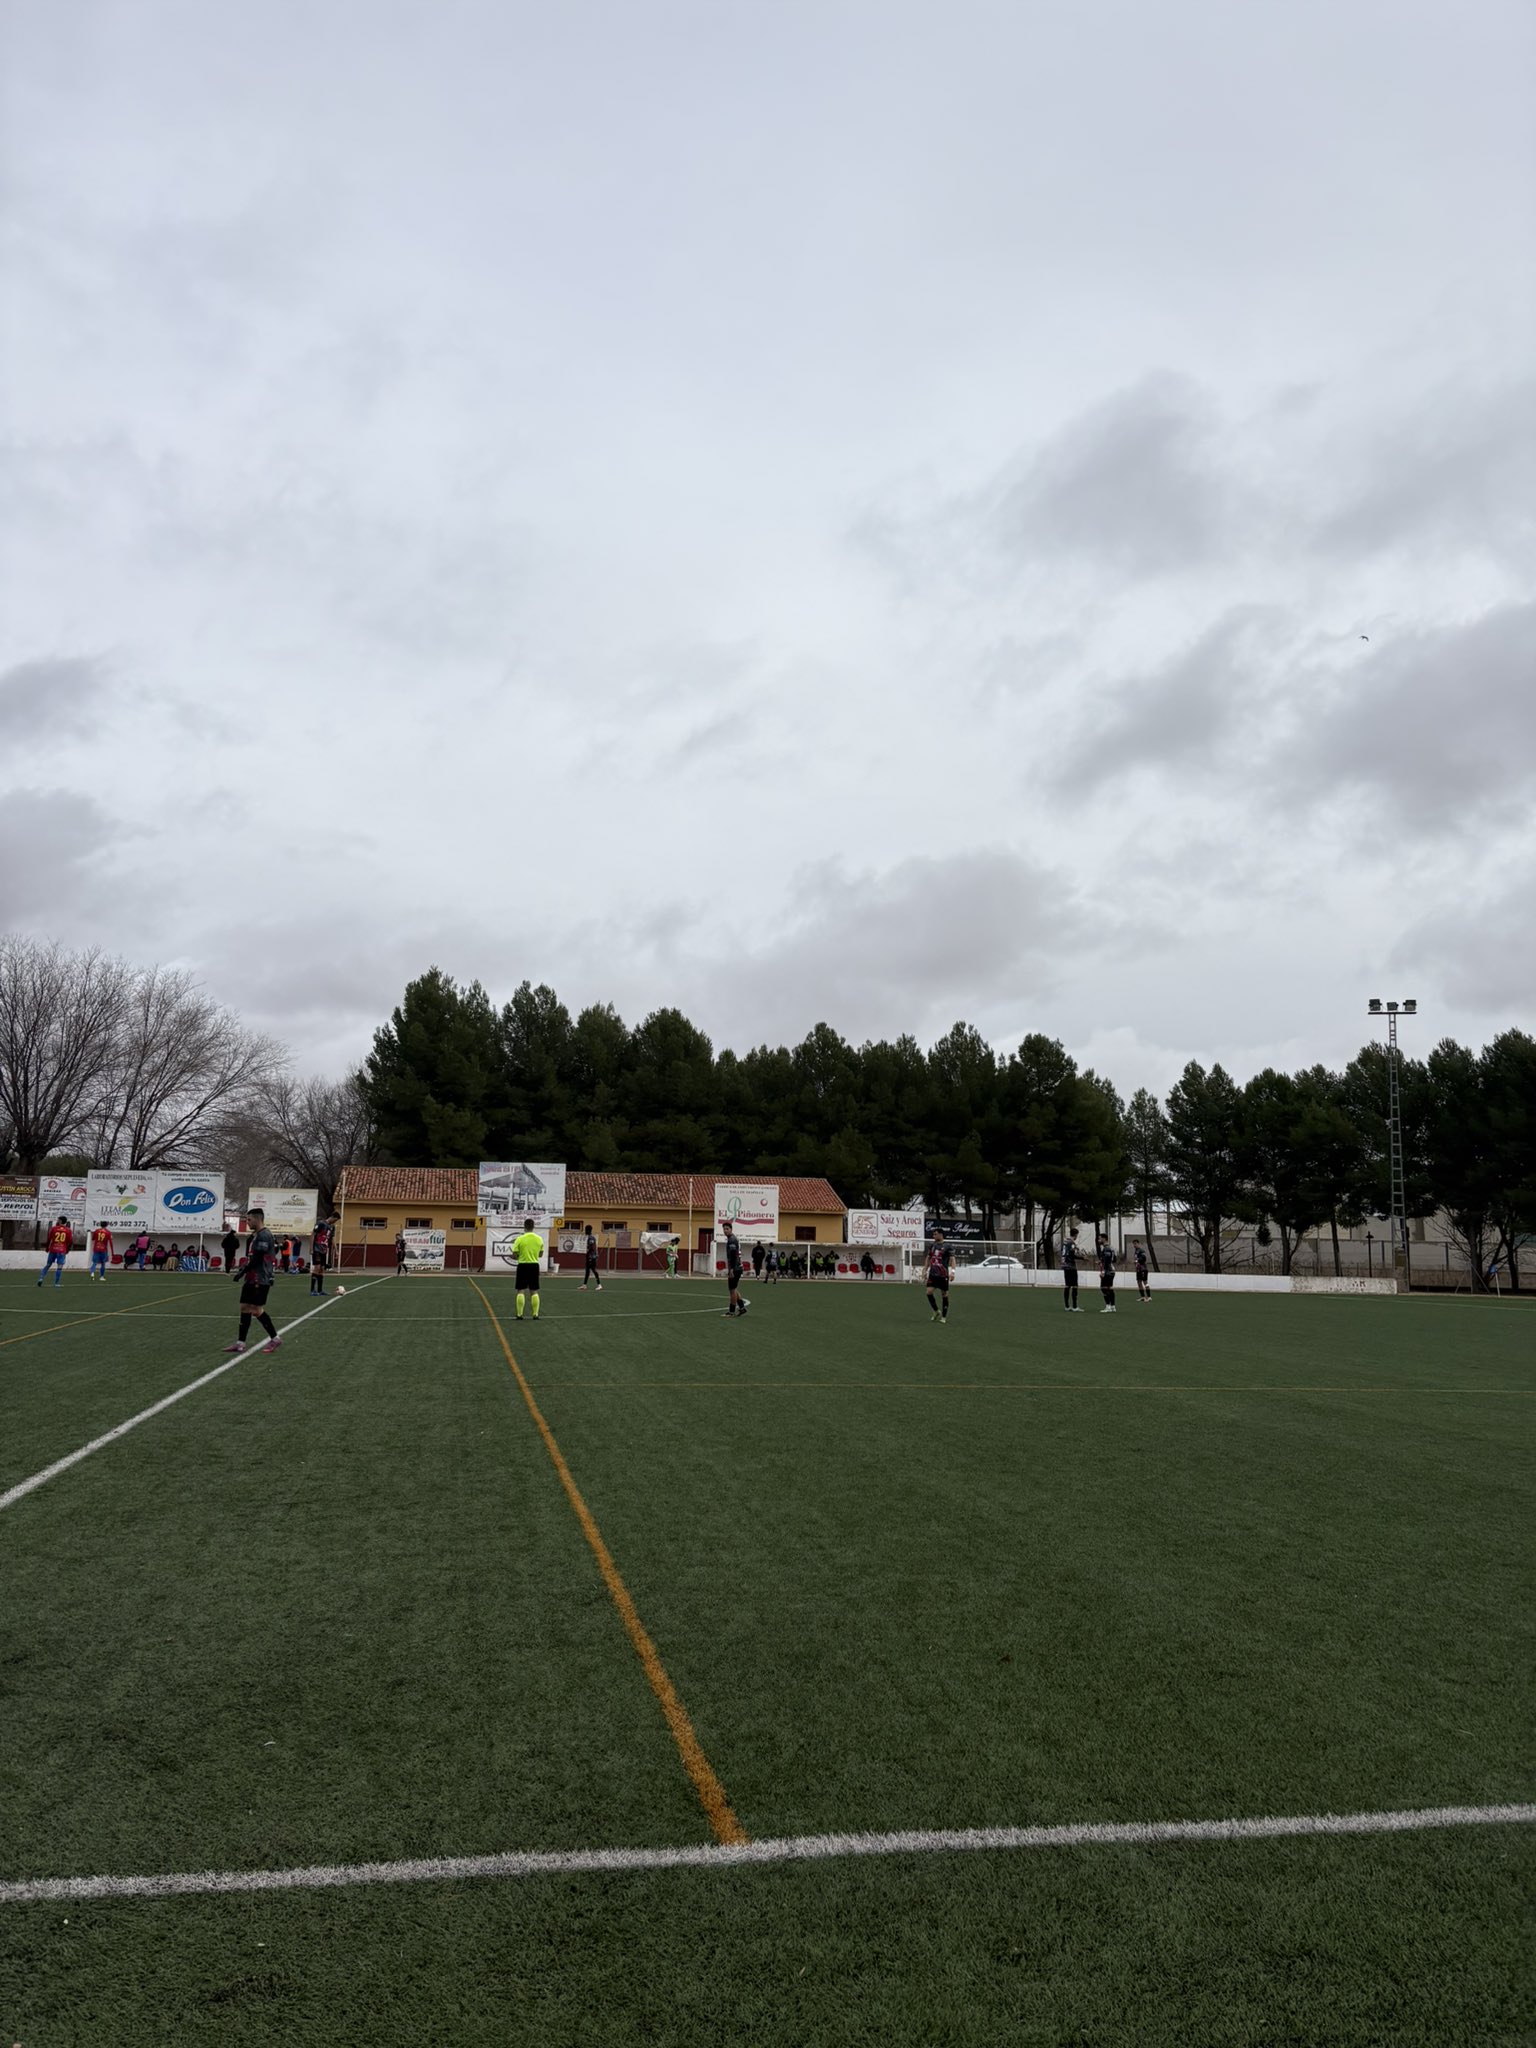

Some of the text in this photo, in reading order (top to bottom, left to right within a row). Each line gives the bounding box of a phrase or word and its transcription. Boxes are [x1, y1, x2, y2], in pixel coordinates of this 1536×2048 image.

[168, 1193, 191, 1207] Don
[718, 1209, 775, 1219] El Piñonero
[880, 1214, 895, 1225] Saiz
[901, 1216, 922, 1225] Aroca
[55, 1232, 67, 1242] 20
[98, 1232, 106, 1242] 19
[887, 1226, 917, 1239] Seguros
